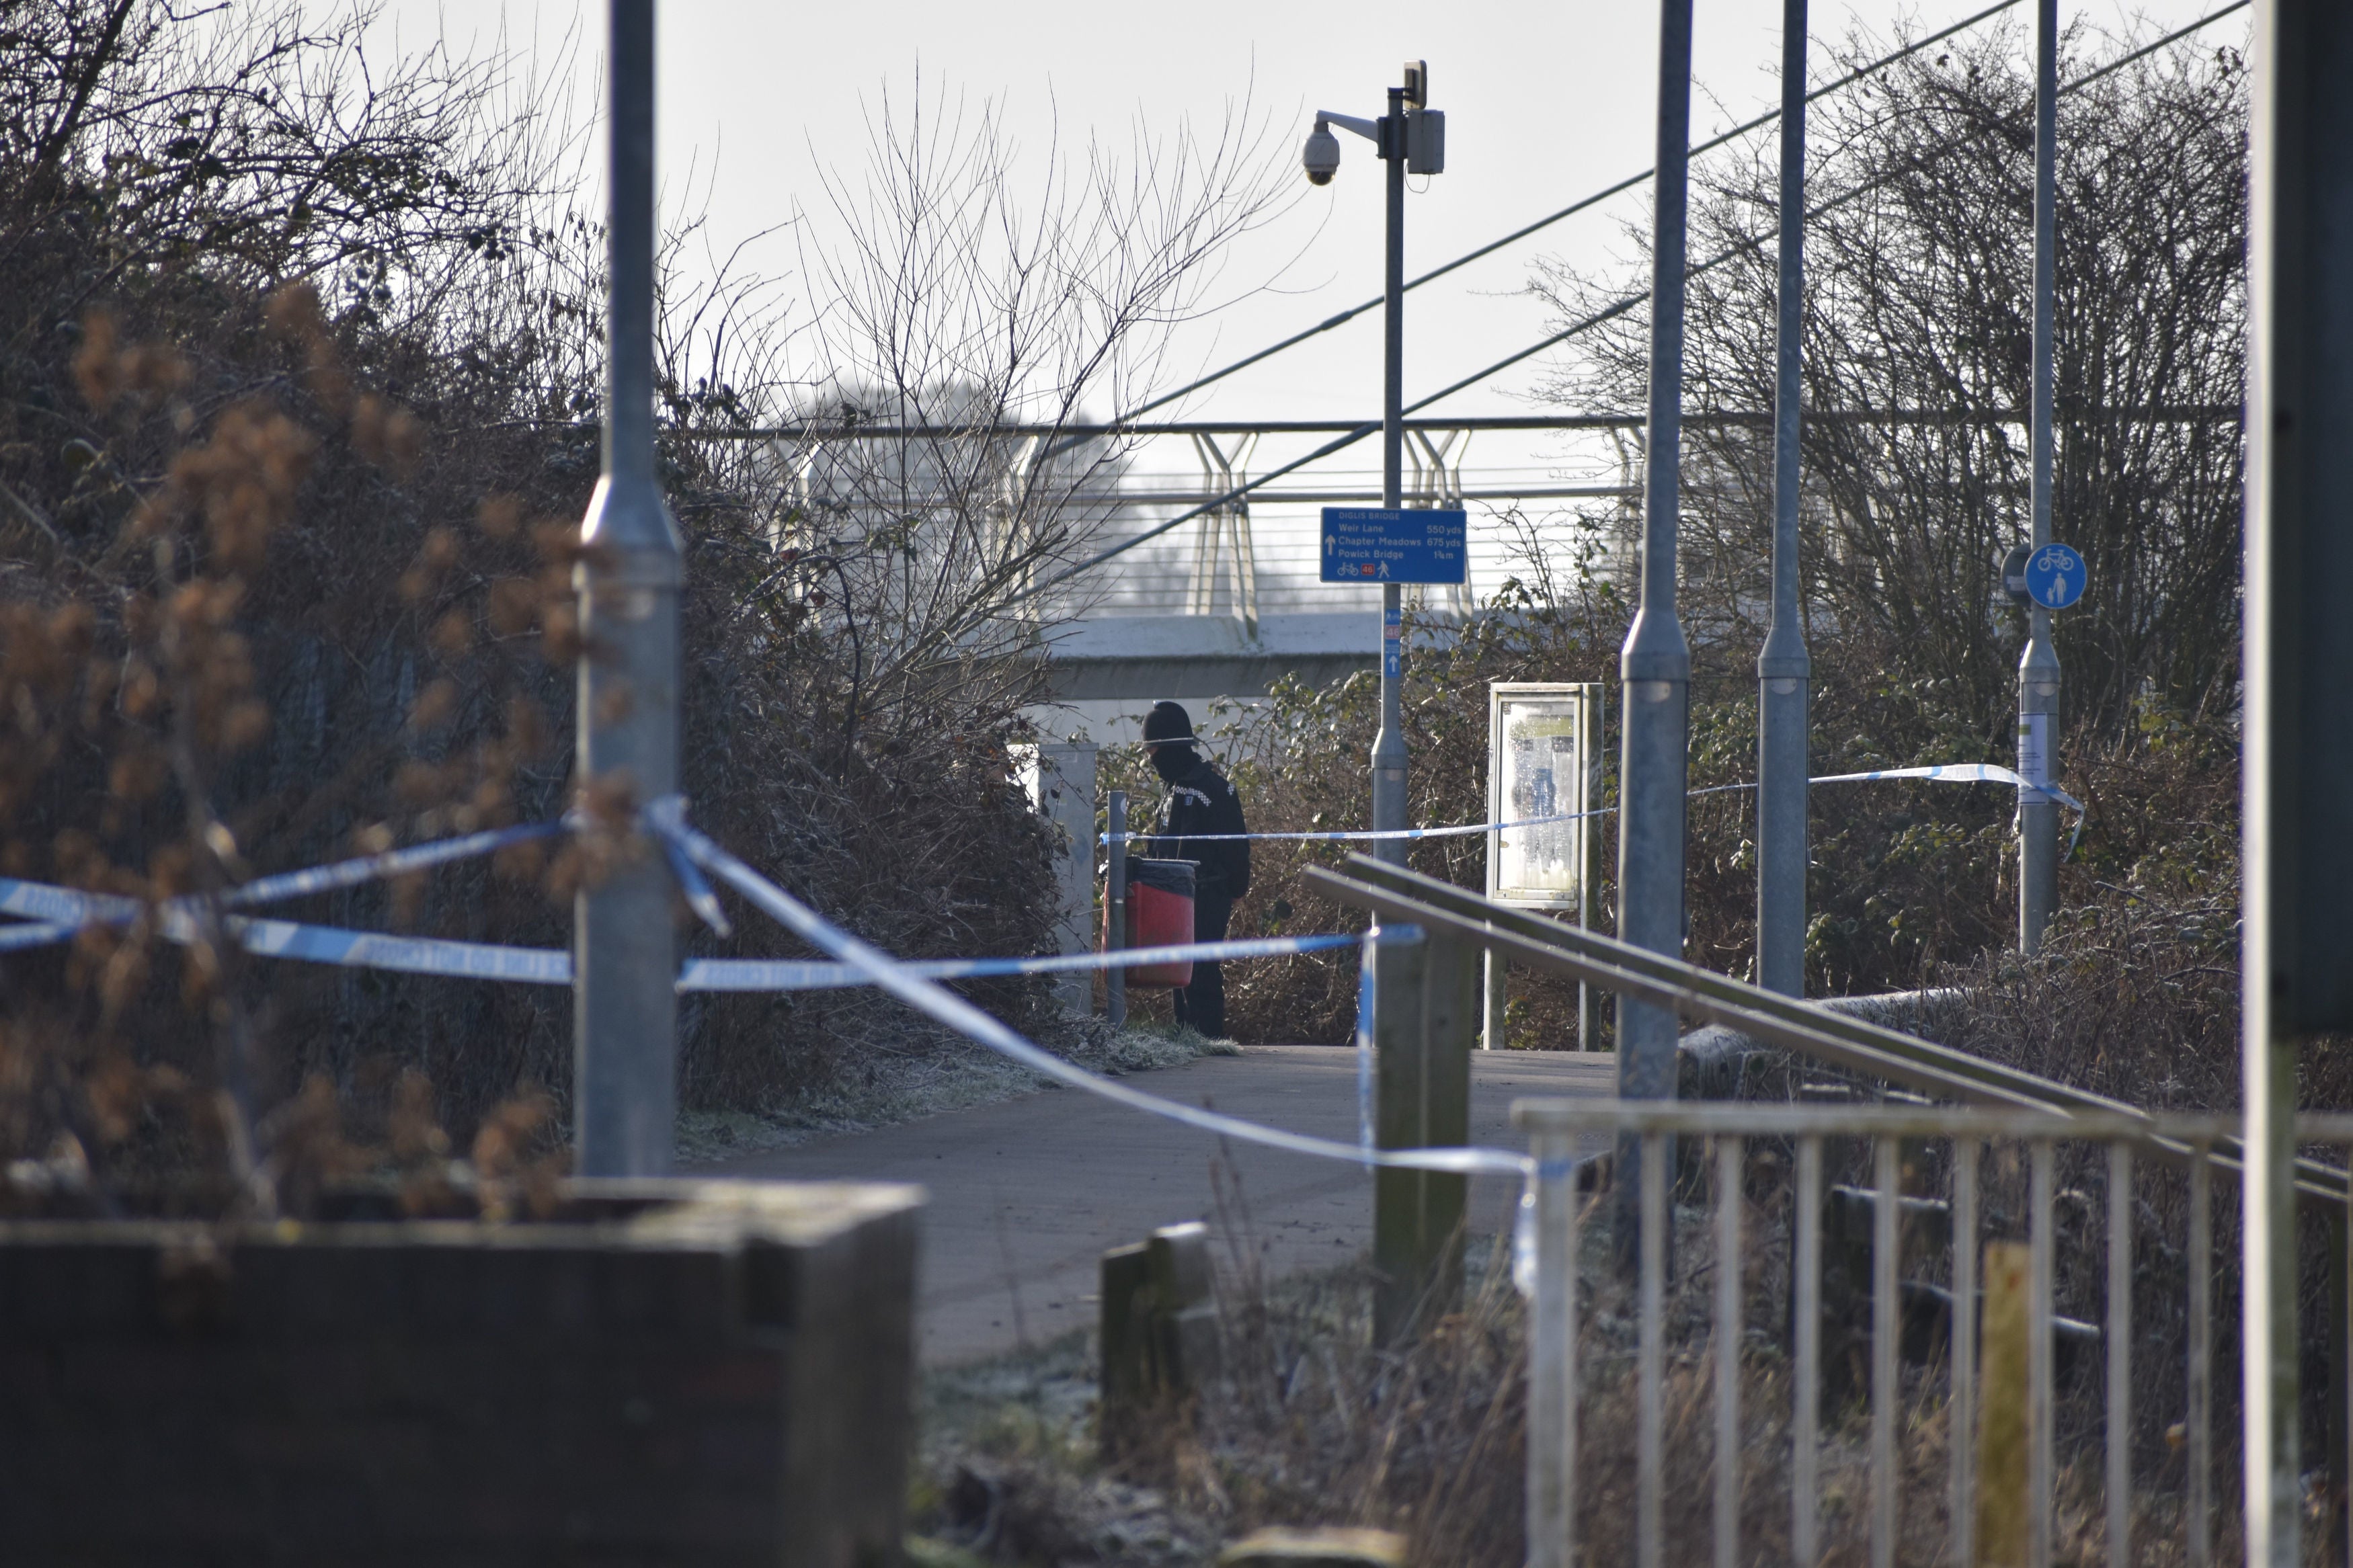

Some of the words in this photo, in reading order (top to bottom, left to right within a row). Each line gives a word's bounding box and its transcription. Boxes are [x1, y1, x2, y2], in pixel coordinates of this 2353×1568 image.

[1339, 511, 1366, 520] DIGLIS
[1369, 512, 1400, 520] BRIDGE
[1339, 524, 1359, 532] Weir
[1363, 524, 1384, 533] Lane
[1427, 525, 1445, 534] 550
[1446, 526, 1462, 536] yds
[1339, 536, 1375, 546] Chapter
[1379, 537, 1421, 546] Meadows
[1427, 538, 1444, 547] 675
[1445, 538, 1462, 548] yds
[1339, 549, 1370, 558] Powick
[1373, 550, 1404, 560] Bridge
[1386, 628, 1400, 636] 46
